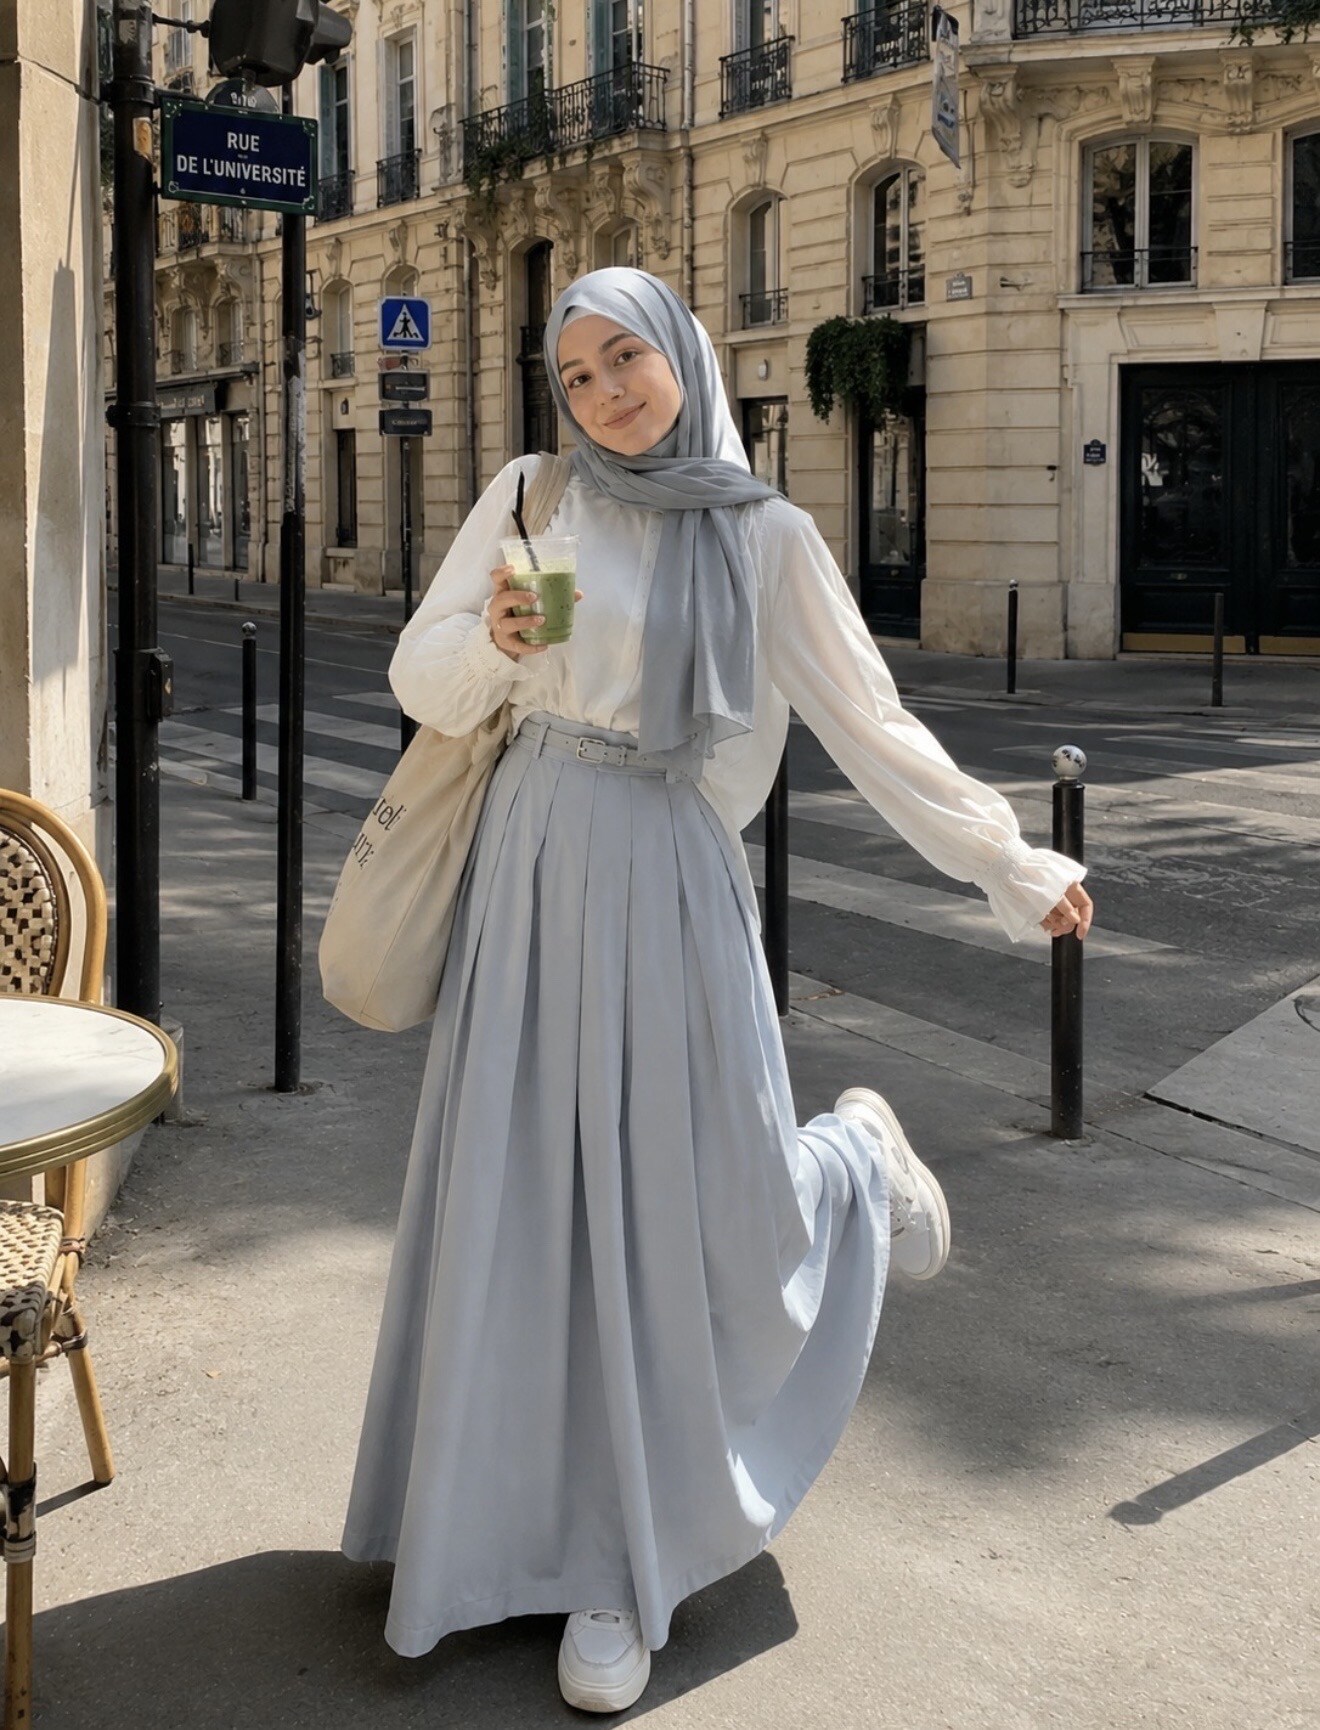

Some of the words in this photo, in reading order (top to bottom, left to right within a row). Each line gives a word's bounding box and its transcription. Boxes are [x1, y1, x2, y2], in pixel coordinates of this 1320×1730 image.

[227, 132, 260, 152] RUE
[176, 155, 198, 174] DE
[203, 158, 306, 187] L'UNIVERSITÉ
